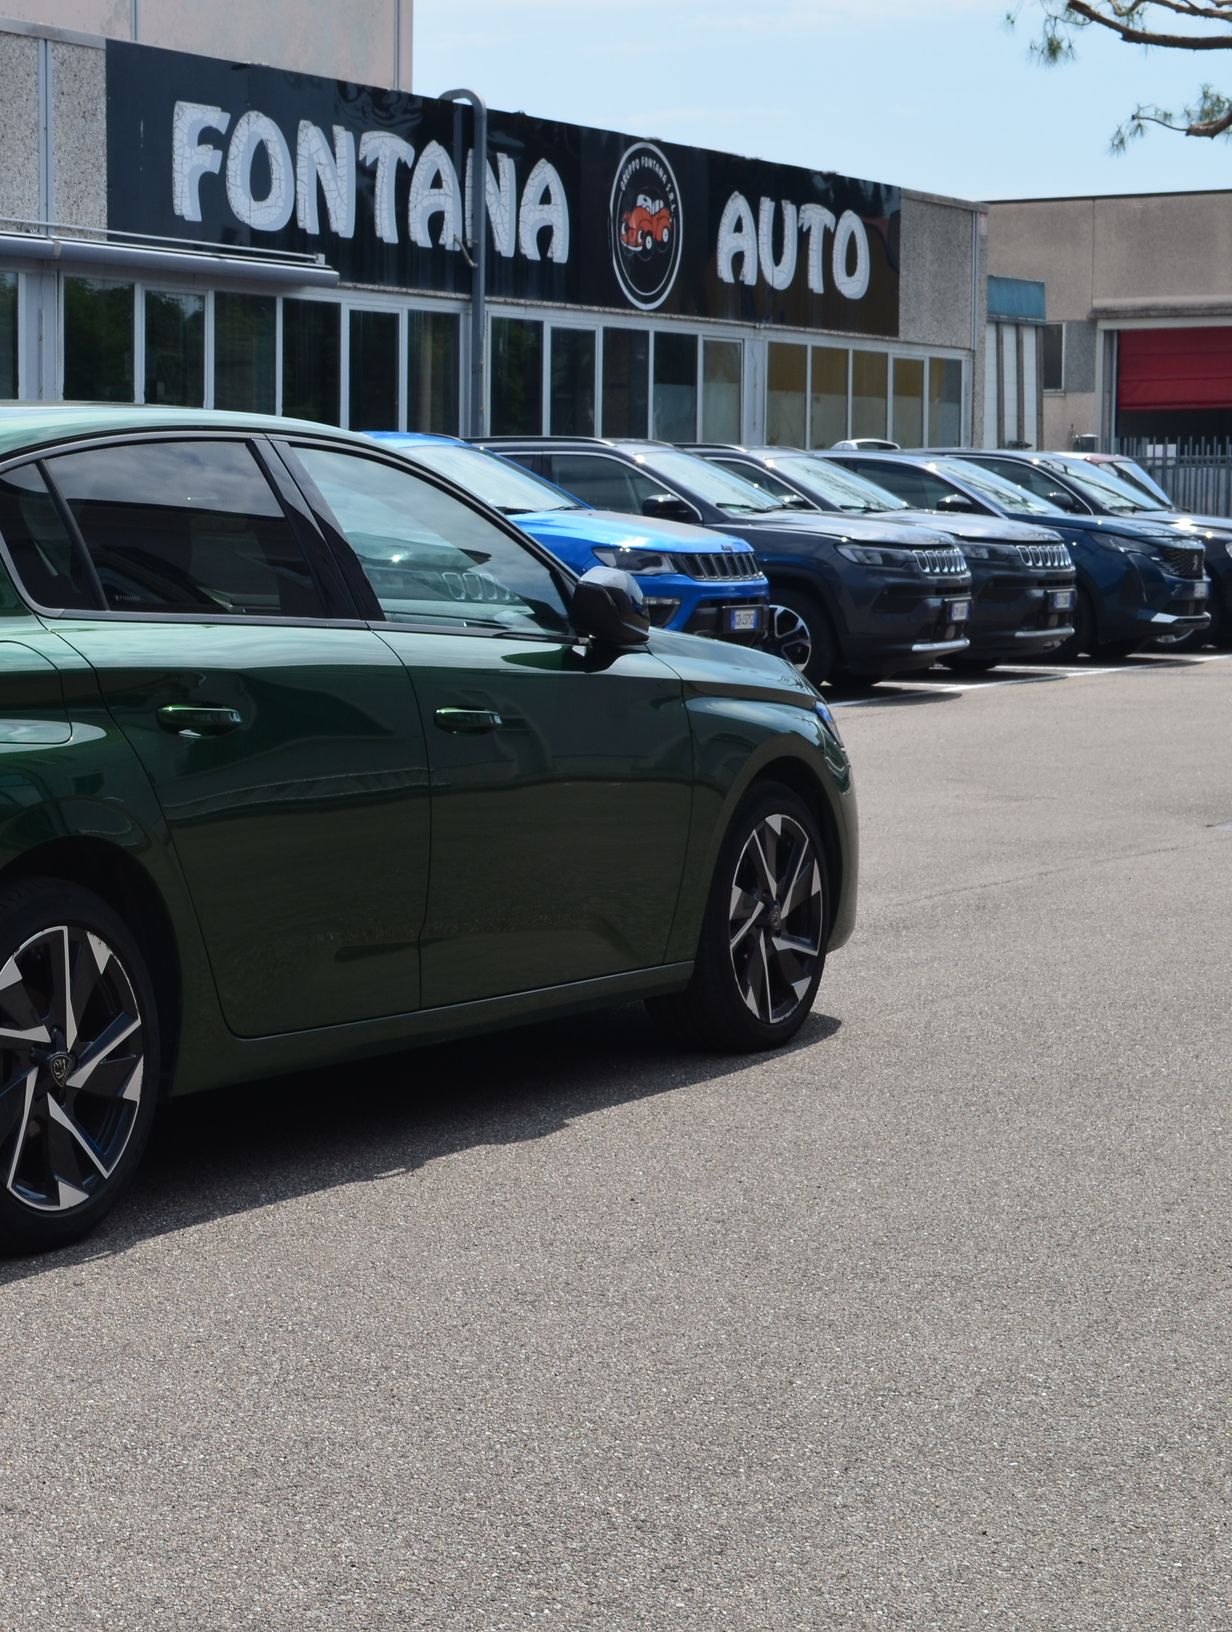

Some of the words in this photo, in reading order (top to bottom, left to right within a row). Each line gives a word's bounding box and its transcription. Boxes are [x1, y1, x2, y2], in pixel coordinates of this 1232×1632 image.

[172, 100, 569, 264] FONTANA
[620, 158, 640, 191] GRUPPO
[641, 156, 667, 184] FONTANA
[716, 190, 871, 300] AUTO
